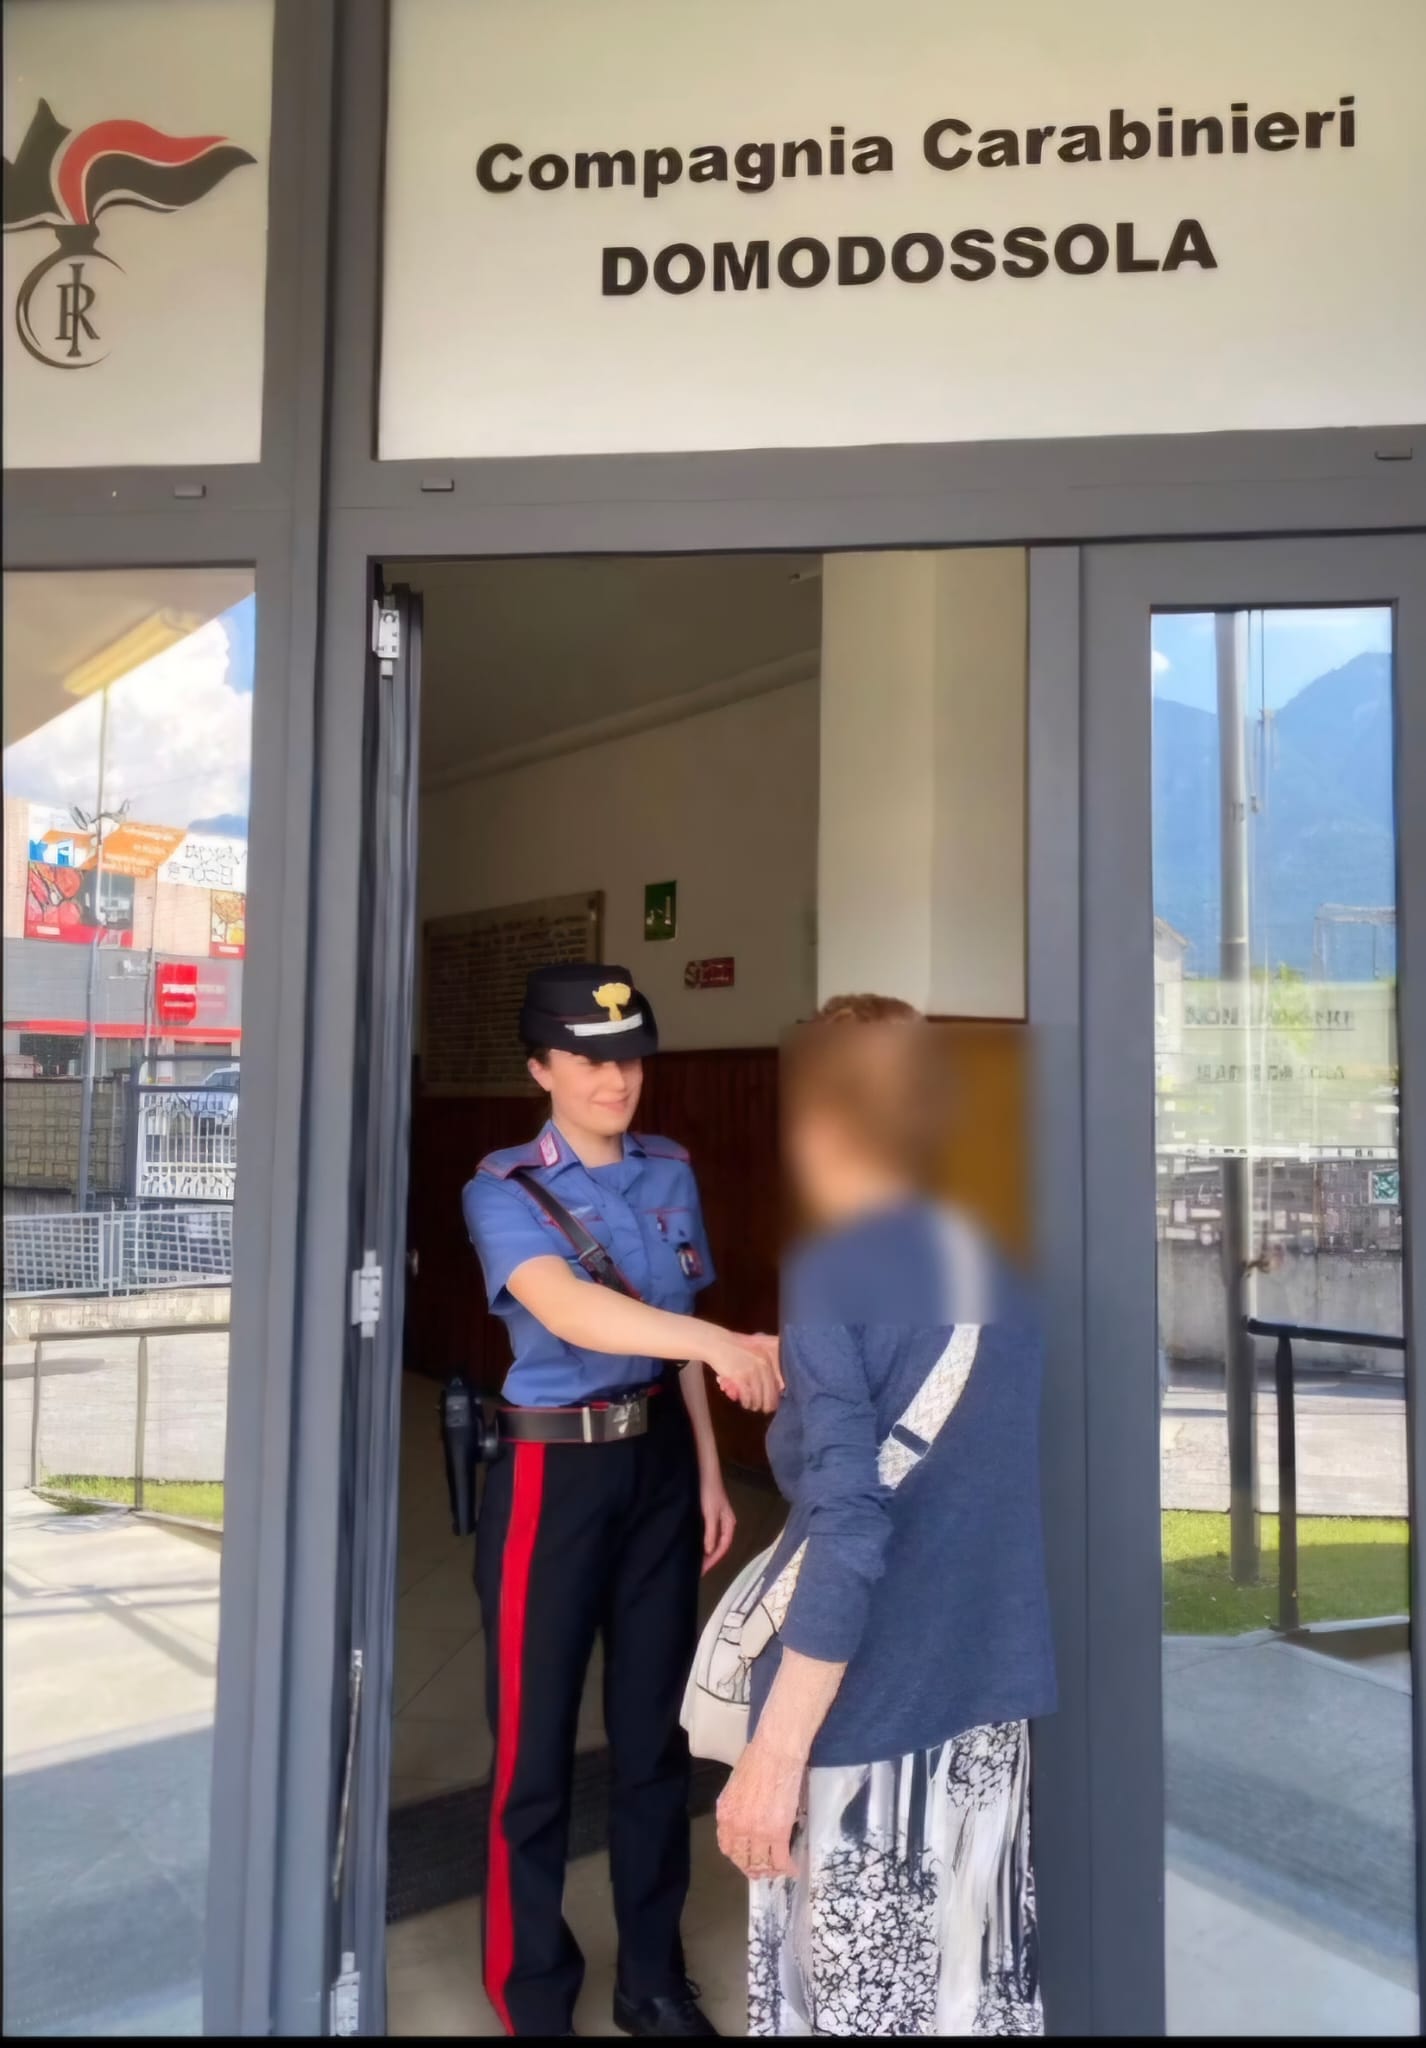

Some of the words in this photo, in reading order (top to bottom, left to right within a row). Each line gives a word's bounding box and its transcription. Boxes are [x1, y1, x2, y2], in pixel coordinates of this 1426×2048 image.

[477, 126, 893, 199] Compagnia
[924, 96, 1355, 171] Carabinieri
[603, 220, 1218, 296] DOMODOSSOLA
